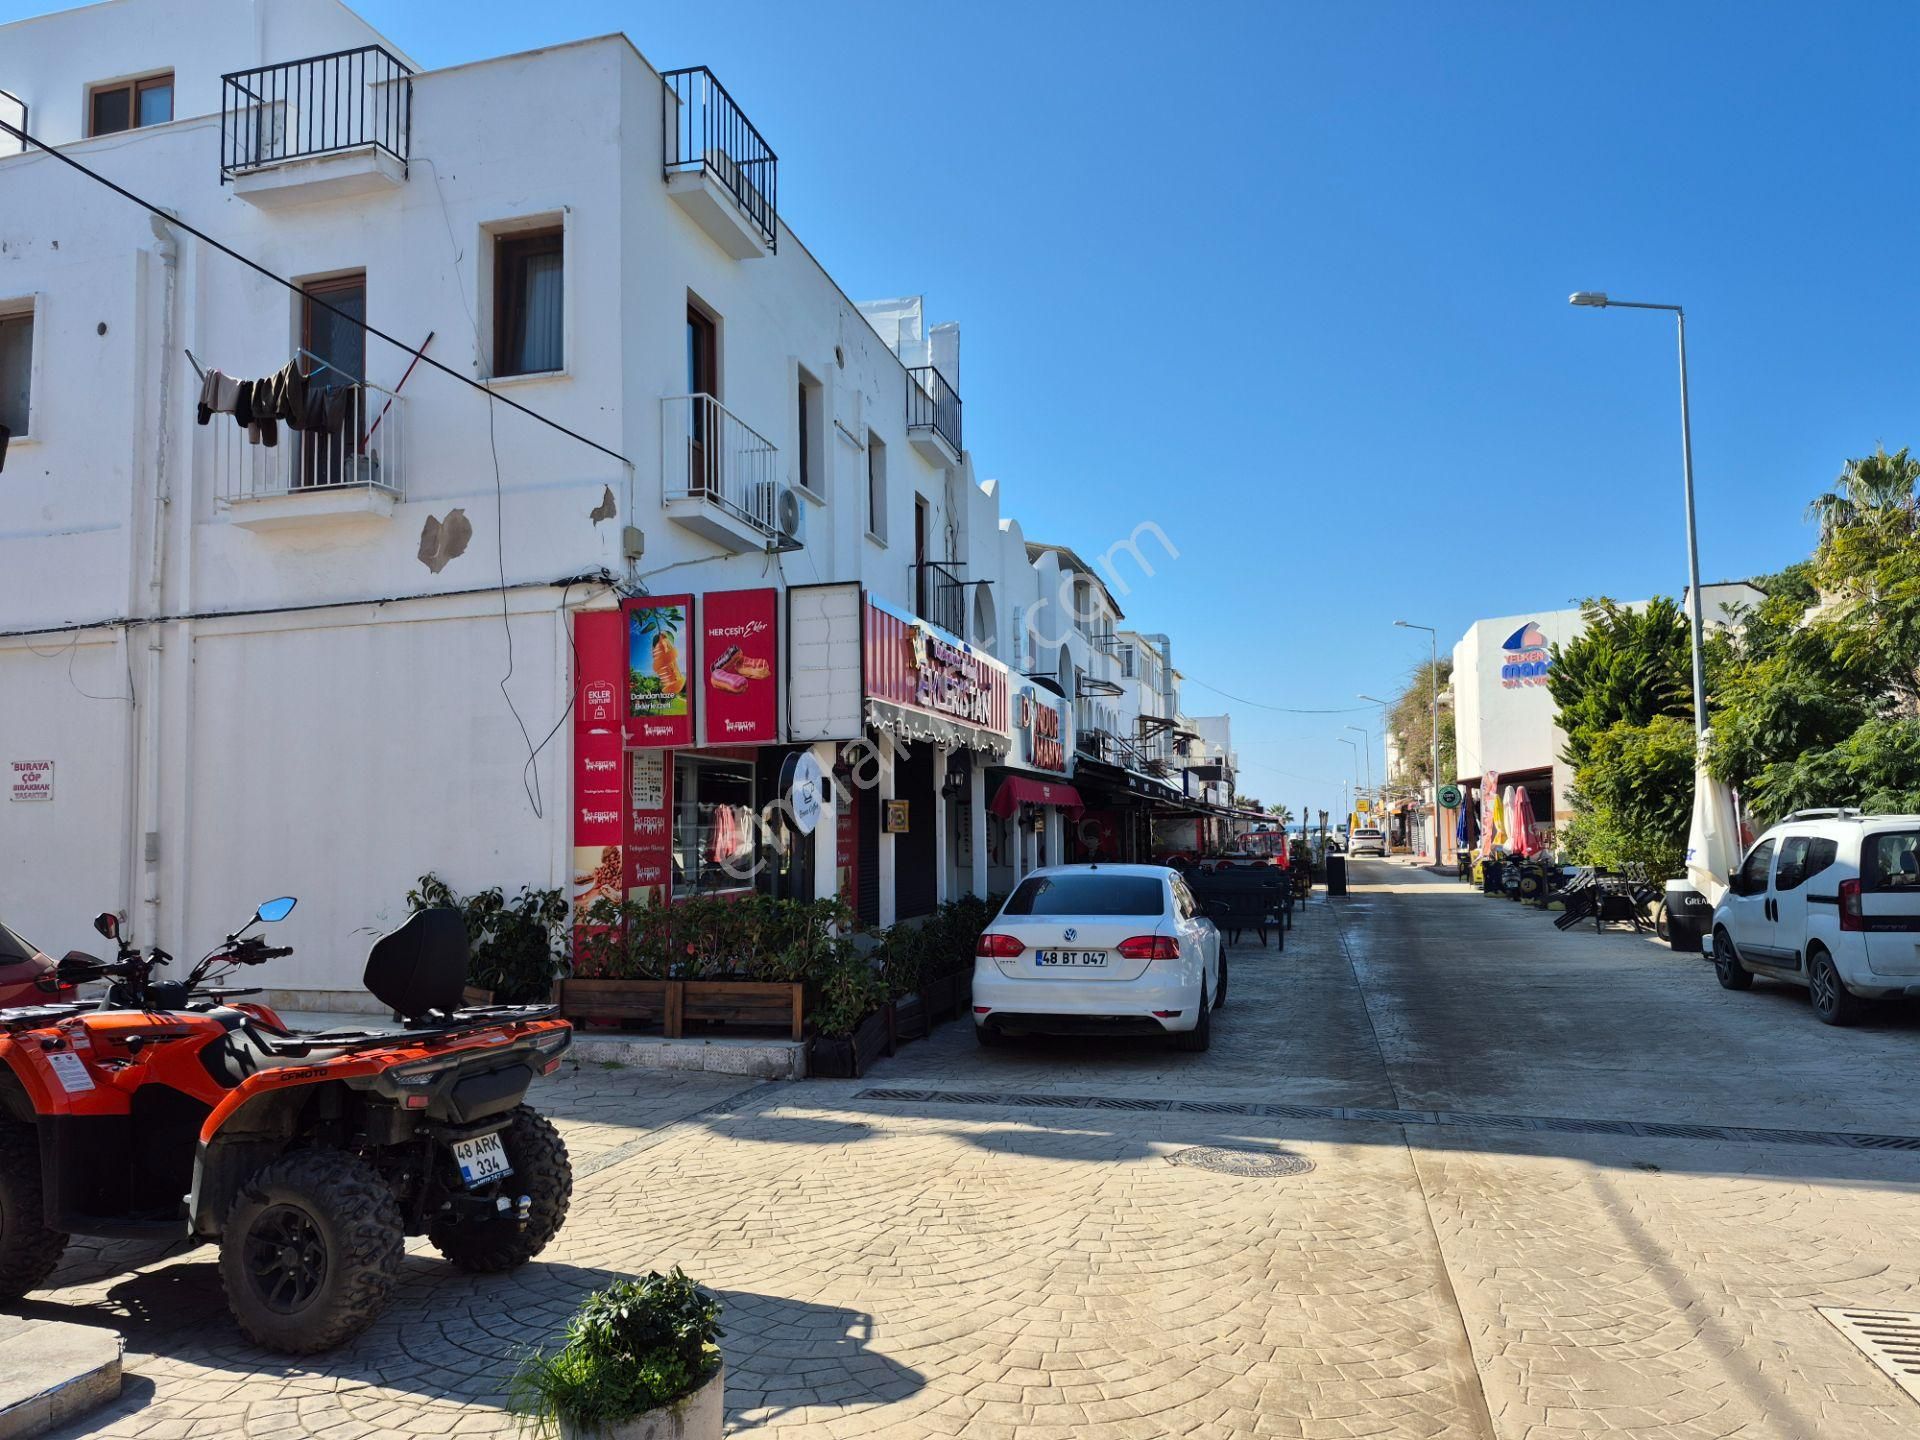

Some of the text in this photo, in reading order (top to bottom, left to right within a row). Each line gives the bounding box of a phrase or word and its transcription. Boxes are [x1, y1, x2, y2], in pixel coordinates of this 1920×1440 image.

[709, 628, 724, 637] HER
[724, 625, 744, 637] ÇEŞİT
[1504, 651, 1546, 664] YELKEN
[588, 690, 610, 698] EKLER
[14, 762, 49, 771] BURAYA
[22, 772, 41, 784] ÇÖP
[1685, 896, 1709, 905] GREA
[1043, 951, 1105, 965] 48 BT 047
[281, 1069, 328, 1081] CFMOTO
[457, 1134, 501, 1160] 48 ARK
[477, 1156, 500, 1176] 334
